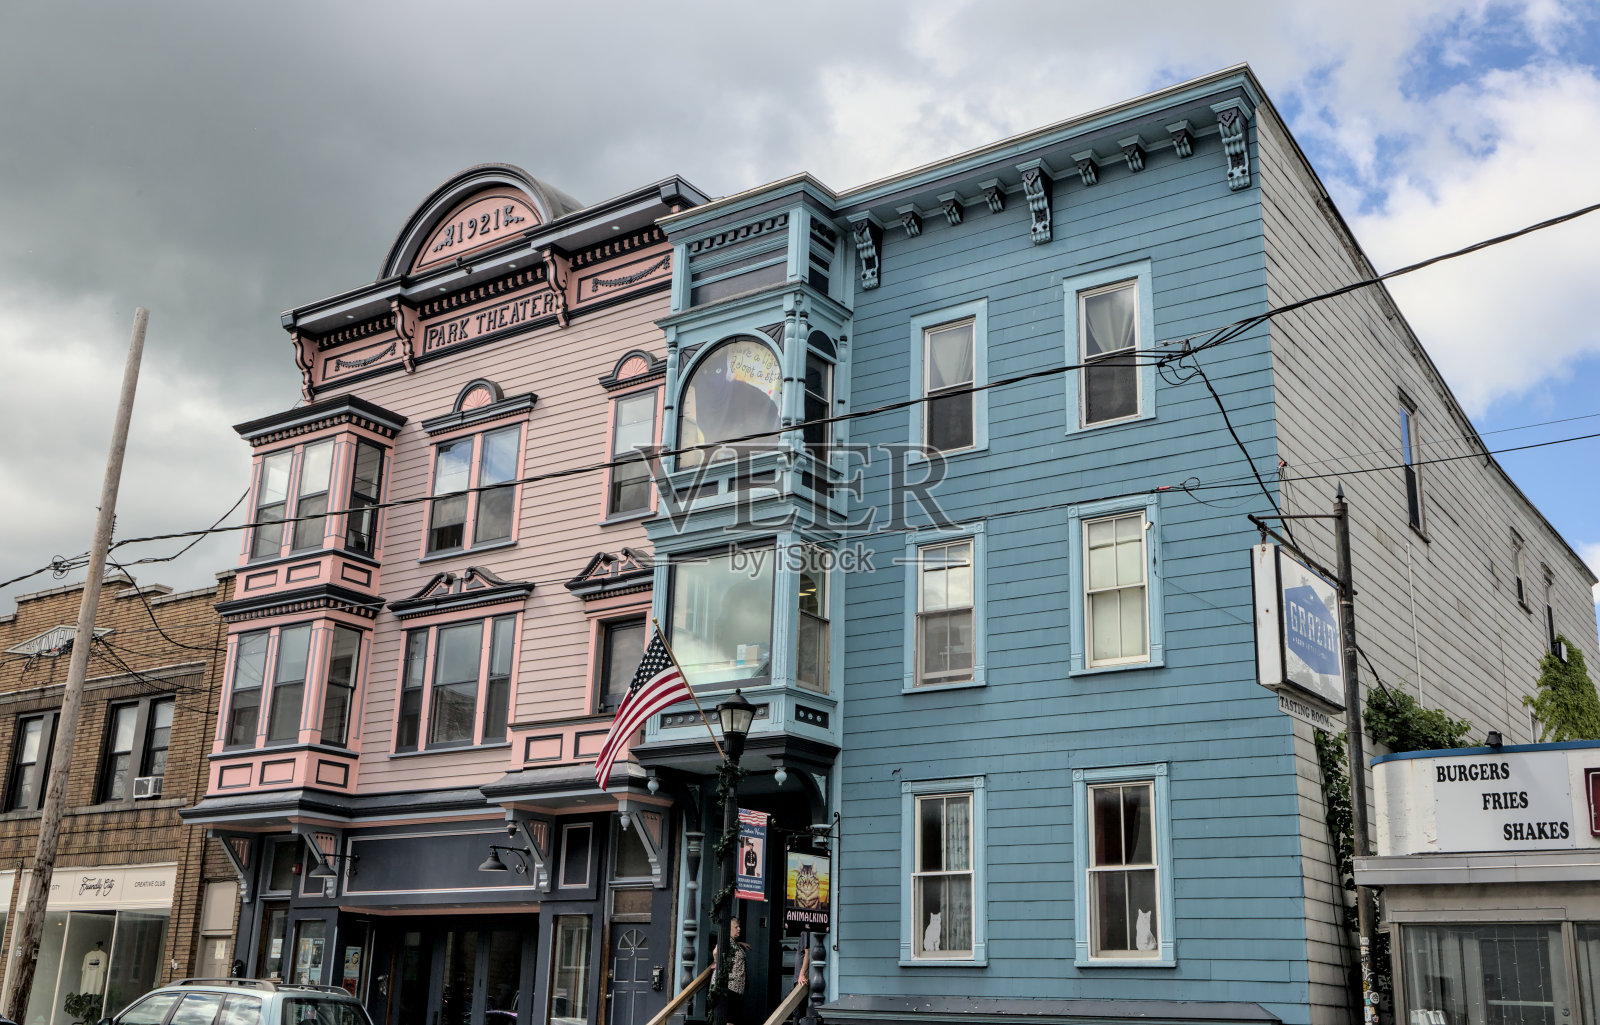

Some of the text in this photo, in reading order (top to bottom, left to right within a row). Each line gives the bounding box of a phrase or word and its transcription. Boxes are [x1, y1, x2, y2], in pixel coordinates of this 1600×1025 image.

[457, 209, 500, 243] 1921
[428, 292, 554, 350] PARK THEATER
[1280, 695, 1330, 727] TASTING ROOM
[1436, 762, 1510, 782] BURGERS
[1482, 791, 1528, 810] FRIES
[1503, 821, 1569, 840] SHAKES
[787, 910, 829, 924] ANIMALKIND
